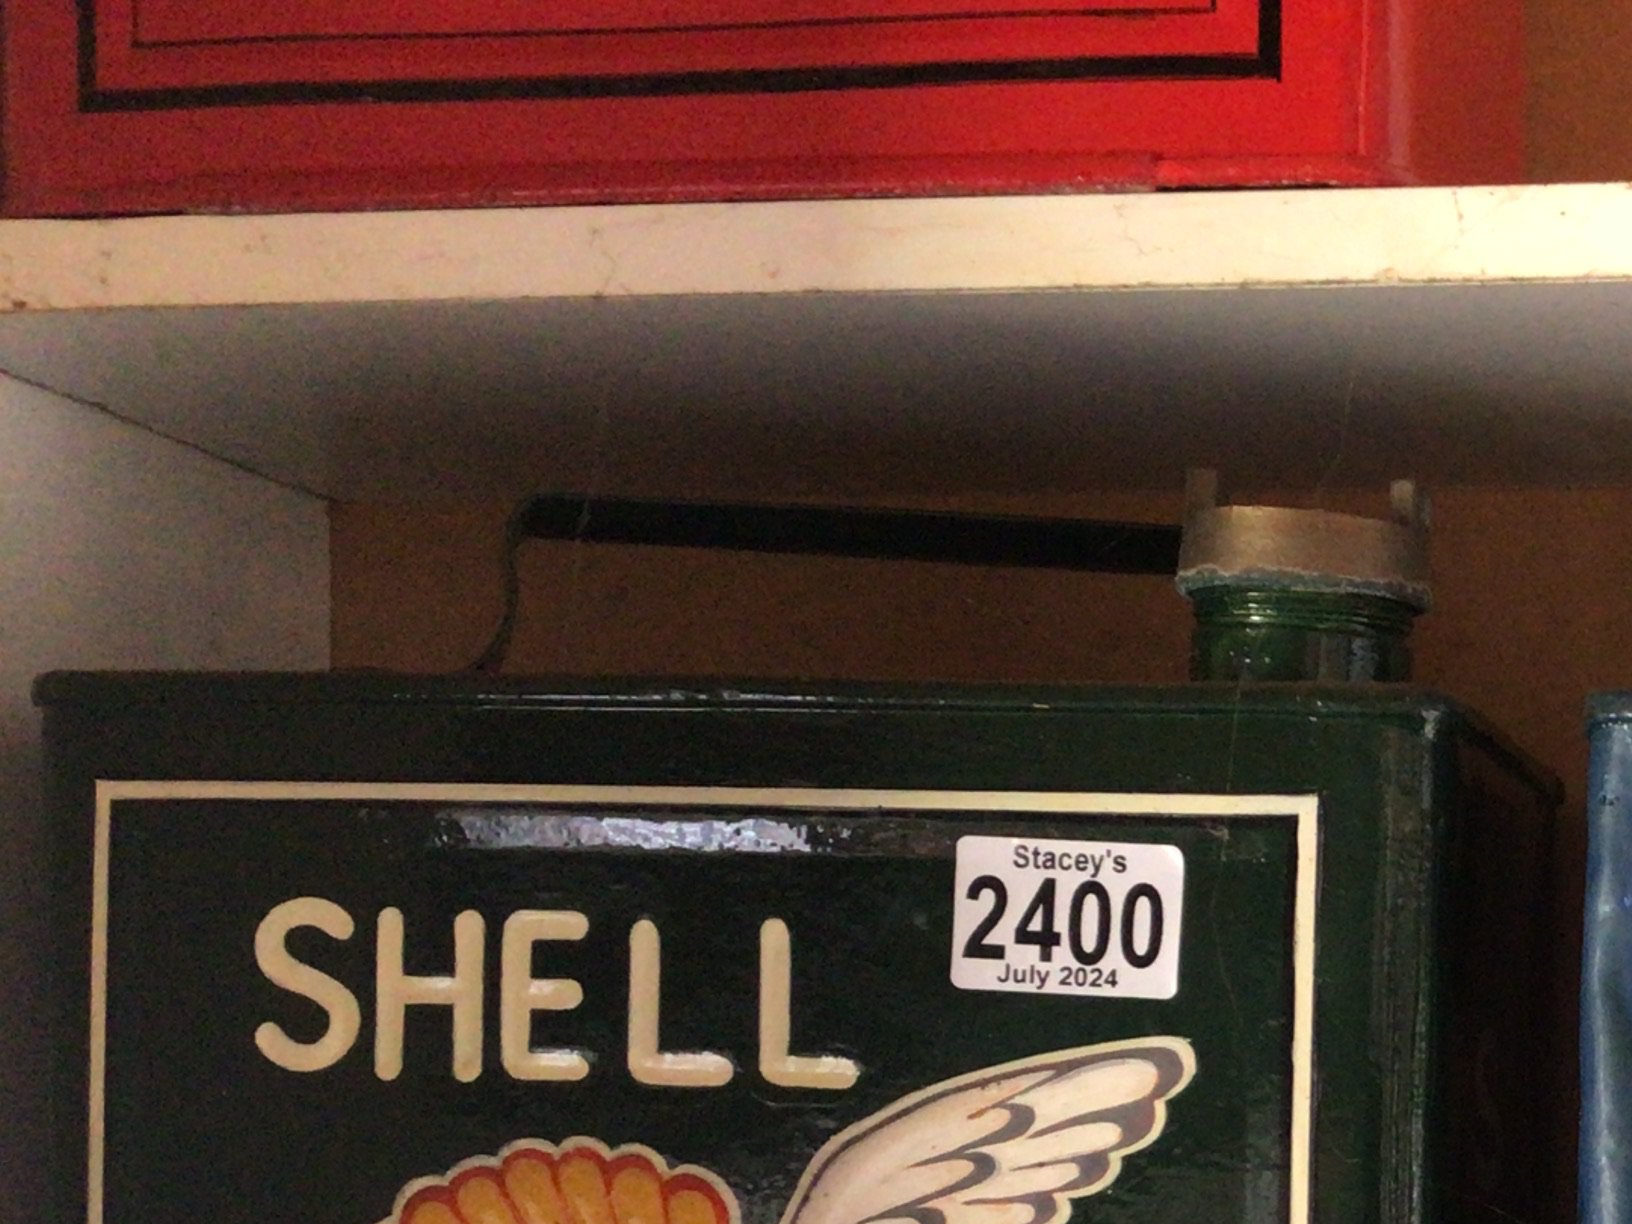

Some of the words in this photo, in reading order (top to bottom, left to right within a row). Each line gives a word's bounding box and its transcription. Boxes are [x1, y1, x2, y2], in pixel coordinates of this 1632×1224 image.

[1012, 844, 1128, 879] Stacey's
[962, 874, 1164, 969] 2400
[254, 895, 861, 1089] SHELL
[996, 963, 1050, 990] July
[1057, 966, 1119, 989] 2024
